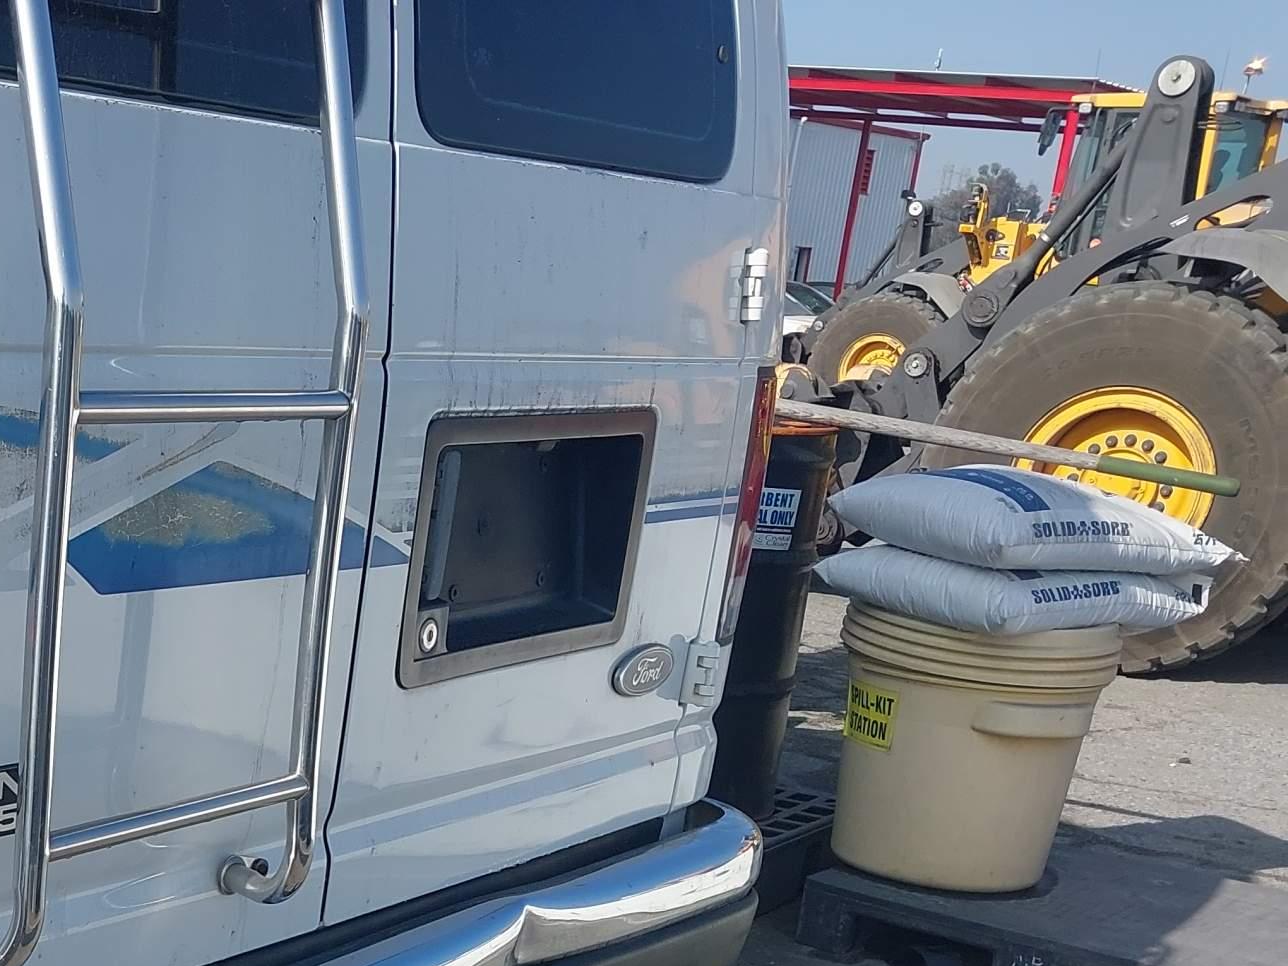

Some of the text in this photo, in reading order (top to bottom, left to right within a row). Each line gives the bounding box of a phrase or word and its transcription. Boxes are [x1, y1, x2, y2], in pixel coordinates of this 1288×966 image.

[769, 510, 795, 526] ONLY
[632, 656, 665, 686] Ford
[851, 685, 895, 717] SPILL-KIT
[849, 711, 888, 741] STATION
